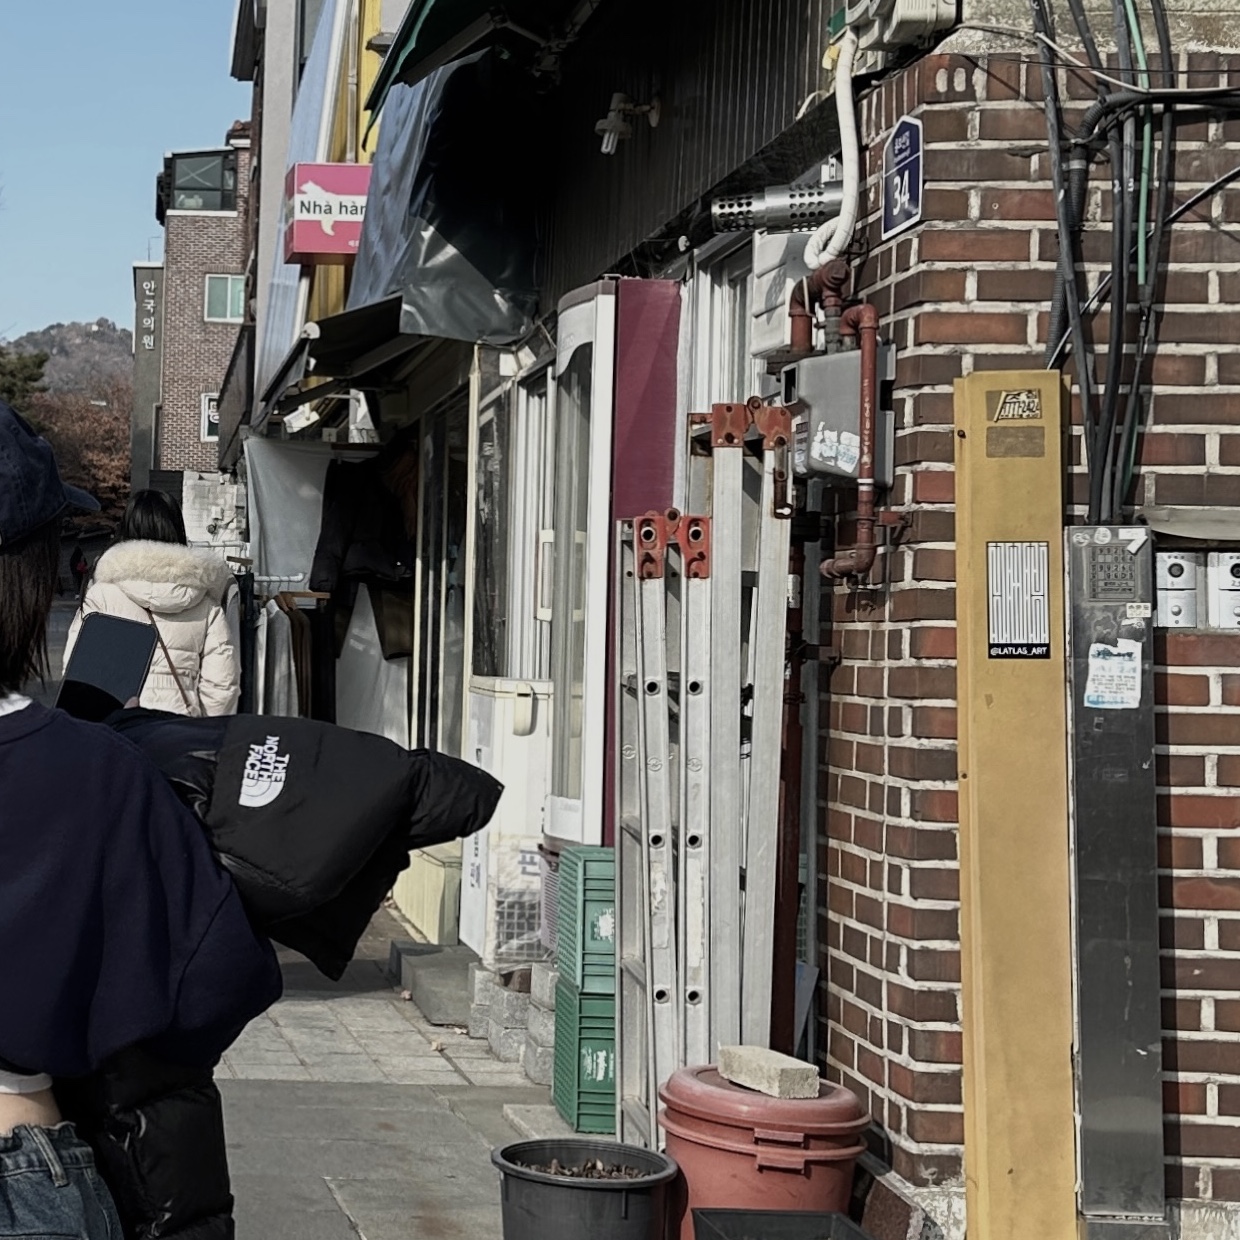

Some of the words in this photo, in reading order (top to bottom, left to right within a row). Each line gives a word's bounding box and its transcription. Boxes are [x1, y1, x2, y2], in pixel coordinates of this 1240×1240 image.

[300, 200, 332, 215] Nhà
[893, 170, 910, 216] 34
[142, 280, 156, 350] 안국의원
[243, 744, 264, 780] FACE
[259, 735, 280, 781] NORTH
[271, 753, 290, 782] THE
